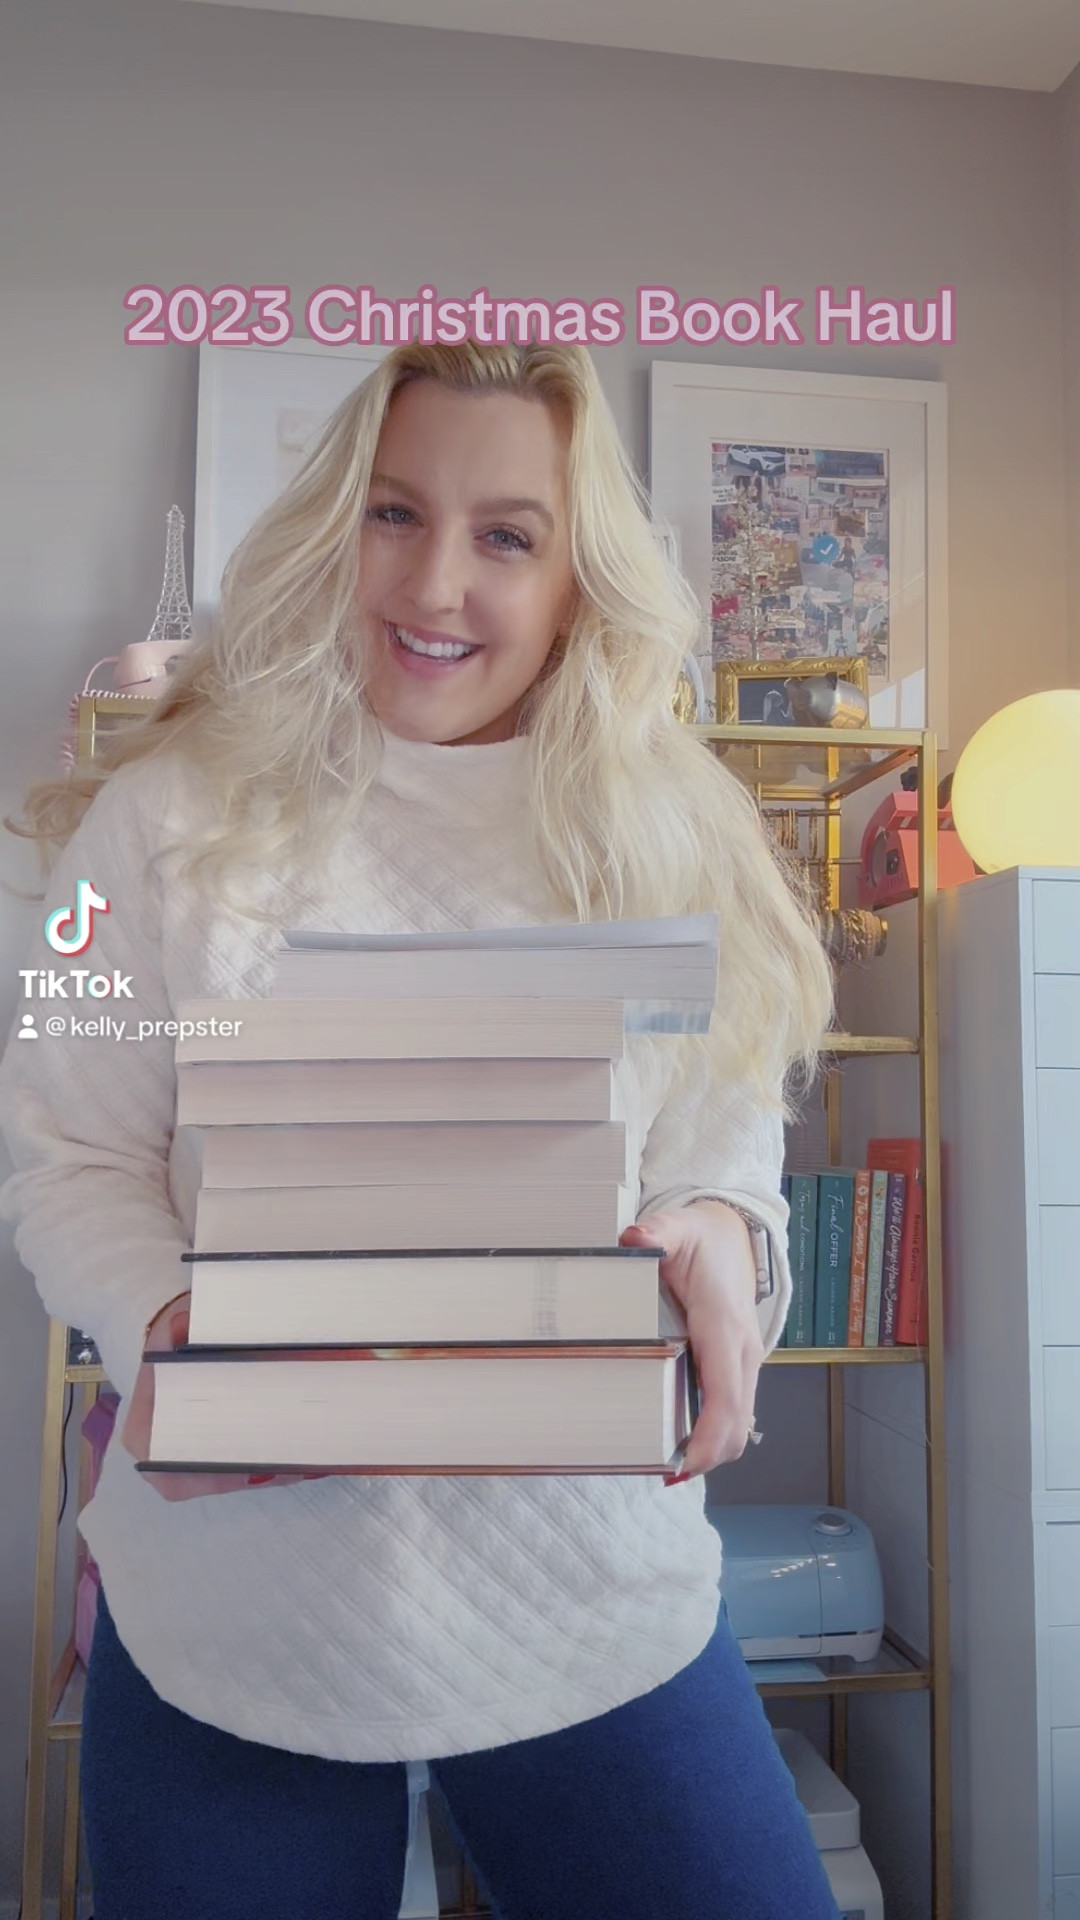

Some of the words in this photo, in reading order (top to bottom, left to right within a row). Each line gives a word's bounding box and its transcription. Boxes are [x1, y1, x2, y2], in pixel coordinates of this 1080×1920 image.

[827, 1194, 844, 1233] Final
[829, 1232, 839, 1268] OFFER
[885, 1225, 902, 1262] Always
[883, 1288, 898, 1335] Summer
